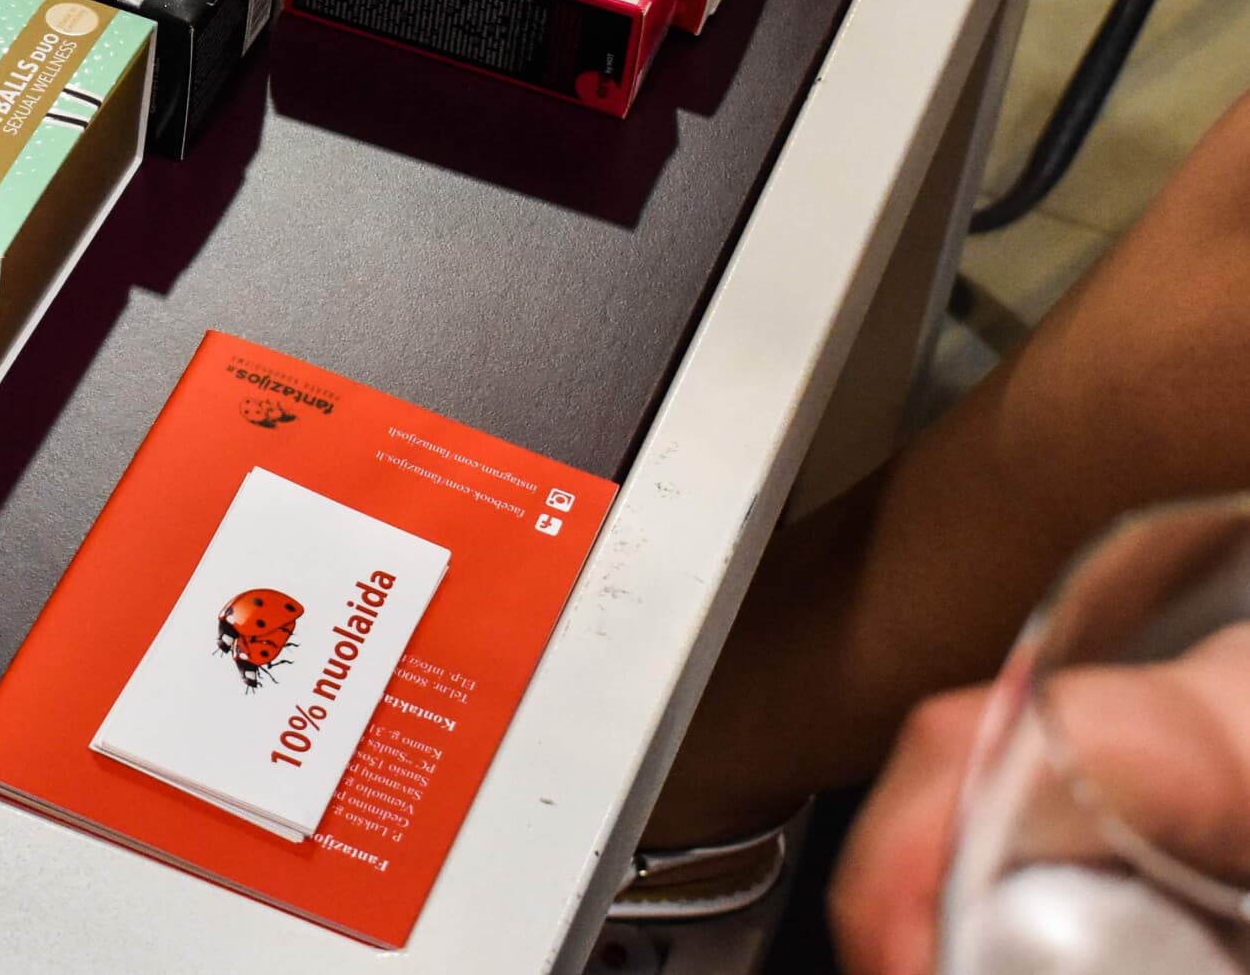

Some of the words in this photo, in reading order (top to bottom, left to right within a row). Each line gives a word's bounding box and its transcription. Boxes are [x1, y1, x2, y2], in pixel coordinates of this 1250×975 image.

[29, 30, 61, 62] DUO
[2, 92, 41, 137] SEXUAL
[32, 38, 78, 93] WELLNESS
[271, 705, 329, 768] 10%
[309, 569, 397, 702] nuolaida
[379, 692, 457, 732] Kontakta
[400, 735, 443, 760] Kauno
[386, 762, 430, 788] Sausio
[415, 757, 437, 774] PC
[346, 795, 410, 828] Gedimino
[354, 782, 416, 814] Vienuolio
[307, 828, 390, 873] Fantazijo
[390, 830, 403, 843] P.
